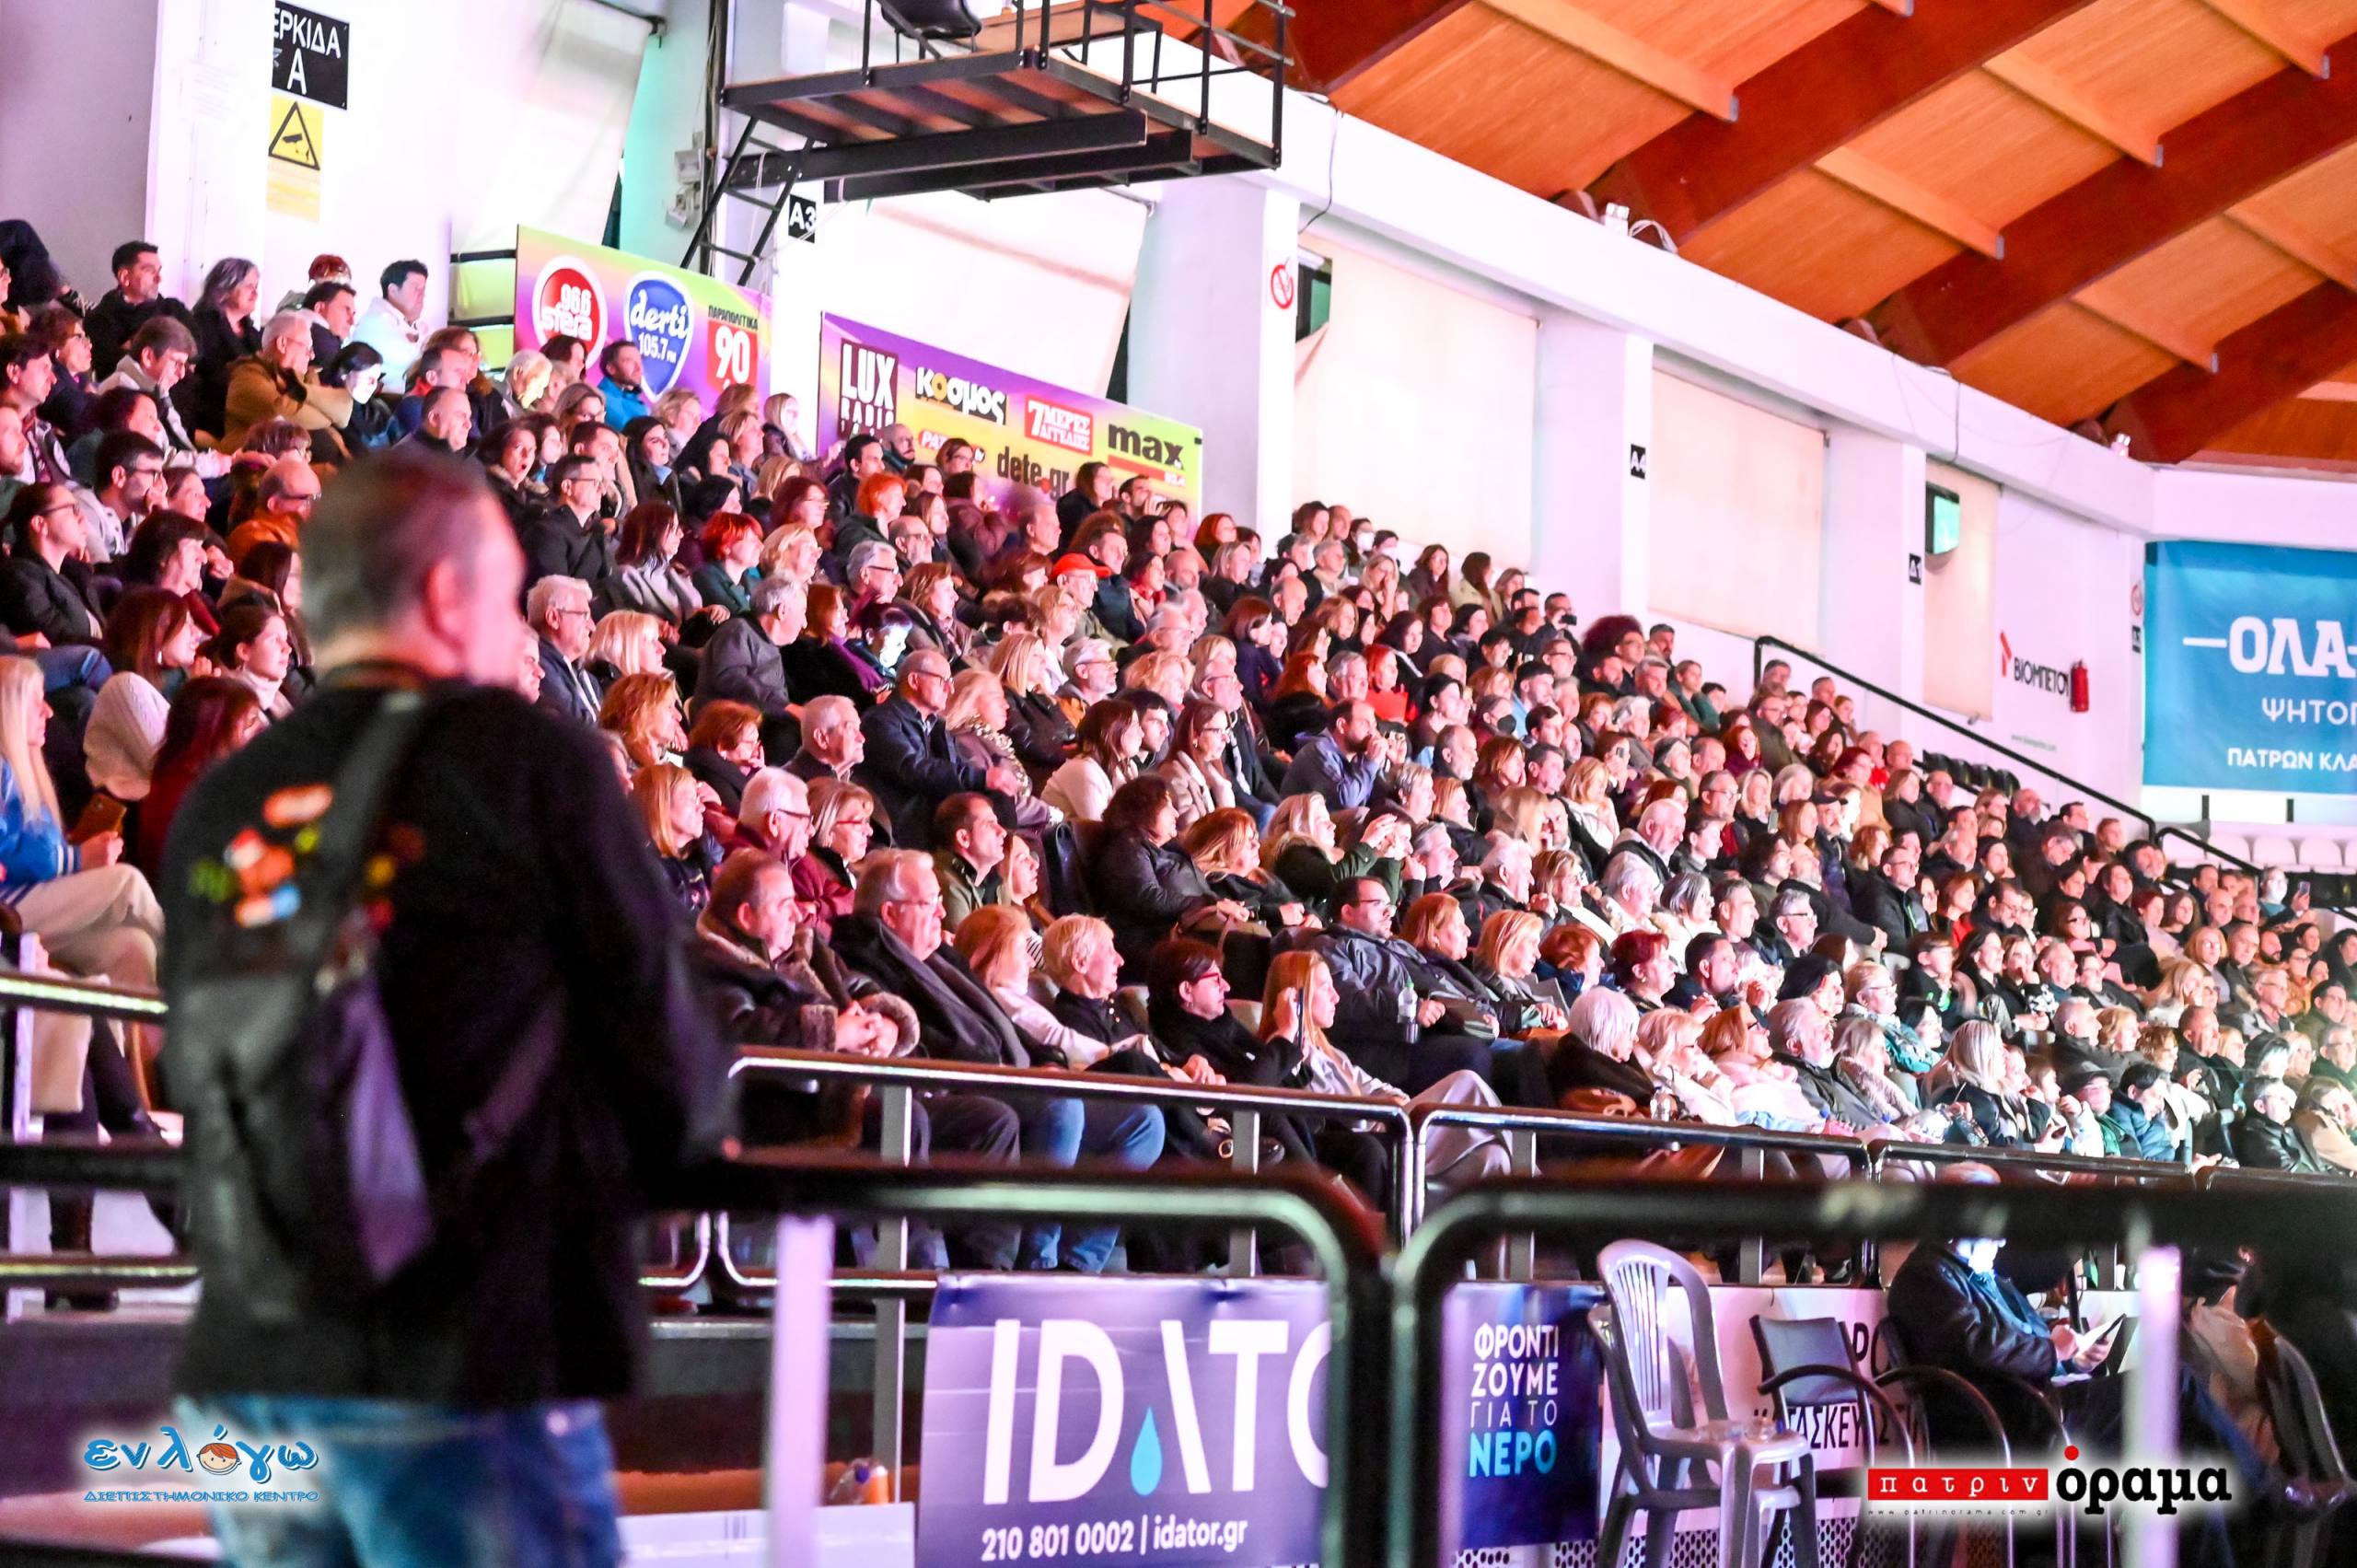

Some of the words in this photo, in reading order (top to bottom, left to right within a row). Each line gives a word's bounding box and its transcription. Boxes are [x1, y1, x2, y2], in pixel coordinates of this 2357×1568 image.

[287, 48, 307, 95] Α
[630, 289, 689, 339] derti
[638, 332, 668, 360] 105.7
[842, 343, 896, 410] LUX
[841, 397, 894, 430] RADIO
[1108, 424, 1185, 470] max
[2229, 616, 2356, 678] ΟΛΑ
[2227, 748, 2313, 770] ΠΑΤΡΩΝ
[1474, 1322, 1559, 1360] ΦΡΟΝΤΙ
[1470, 1362, 1559, 1398] ΖΟΥΜΕ
[1470, 1400, 1512, 1428] ΓΙΑ
[1527, 1400, 1558, 1426] ΤΟ
[1469, 1430, 1558, 1478] ΝΕΡΟ
[981, 1527, 1023, 1562] 210
[1028, 1524, 1069, 1559] 801
[1075, 1520, 1133, 1555] 0002
[1153, 1515, 1248, 1552] idator.gr
